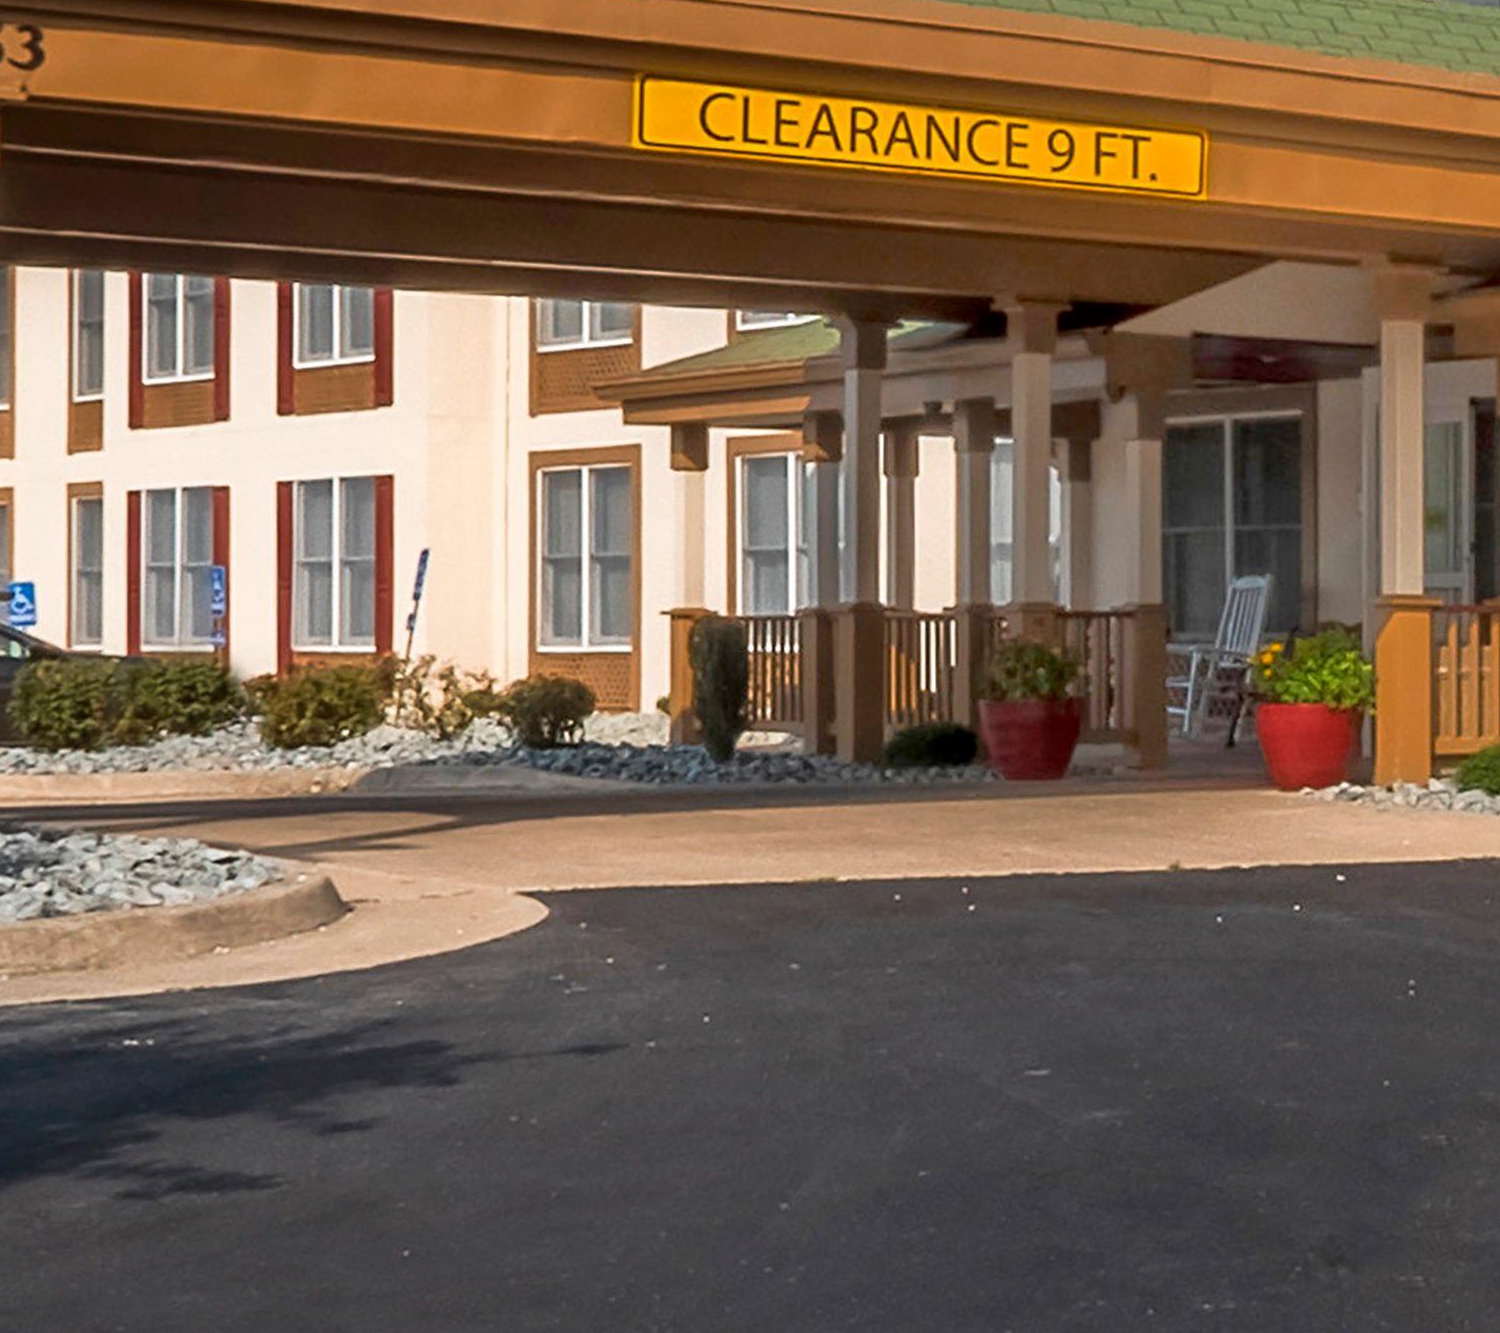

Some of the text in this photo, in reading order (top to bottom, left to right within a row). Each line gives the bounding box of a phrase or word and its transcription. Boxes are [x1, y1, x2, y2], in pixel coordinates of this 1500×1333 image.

[699, 92, 1157, 181] CLEARANCE 9 FT.
